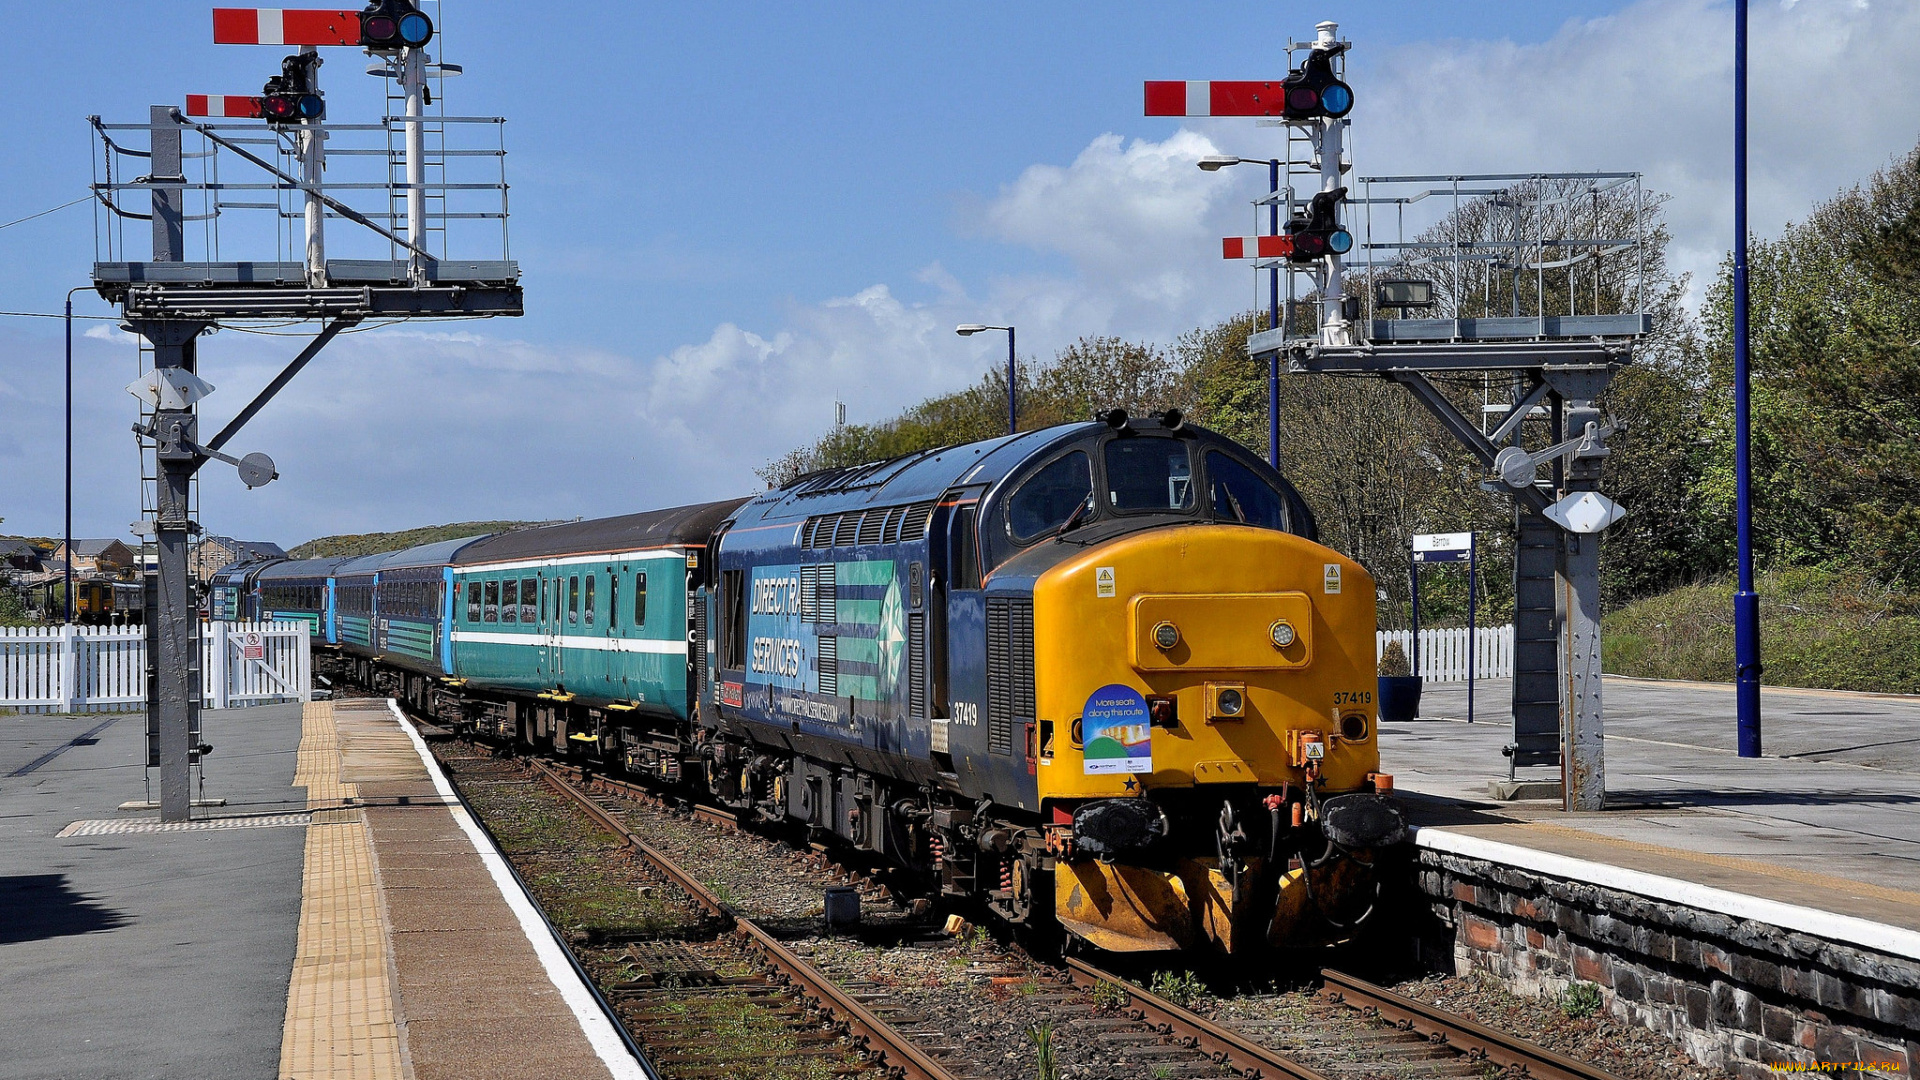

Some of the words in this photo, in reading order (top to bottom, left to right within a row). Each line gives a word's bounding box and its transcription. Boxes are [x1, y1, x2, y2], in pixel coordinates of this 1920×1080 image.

[753, 577, 788, 616] DIRECT
[751, 637, 800, 679] SERVICES
[1095, 699, 1115, 707] More
[1115, 698, 1136, 706] seats
[1333, 691, 1372, 705] 37419
[954, 701, 978, 727] 37419
[1088, 708, 1110, 718] along
[1111, 708, 1124, 716] this
[1124, 708, 1144, 716] route
